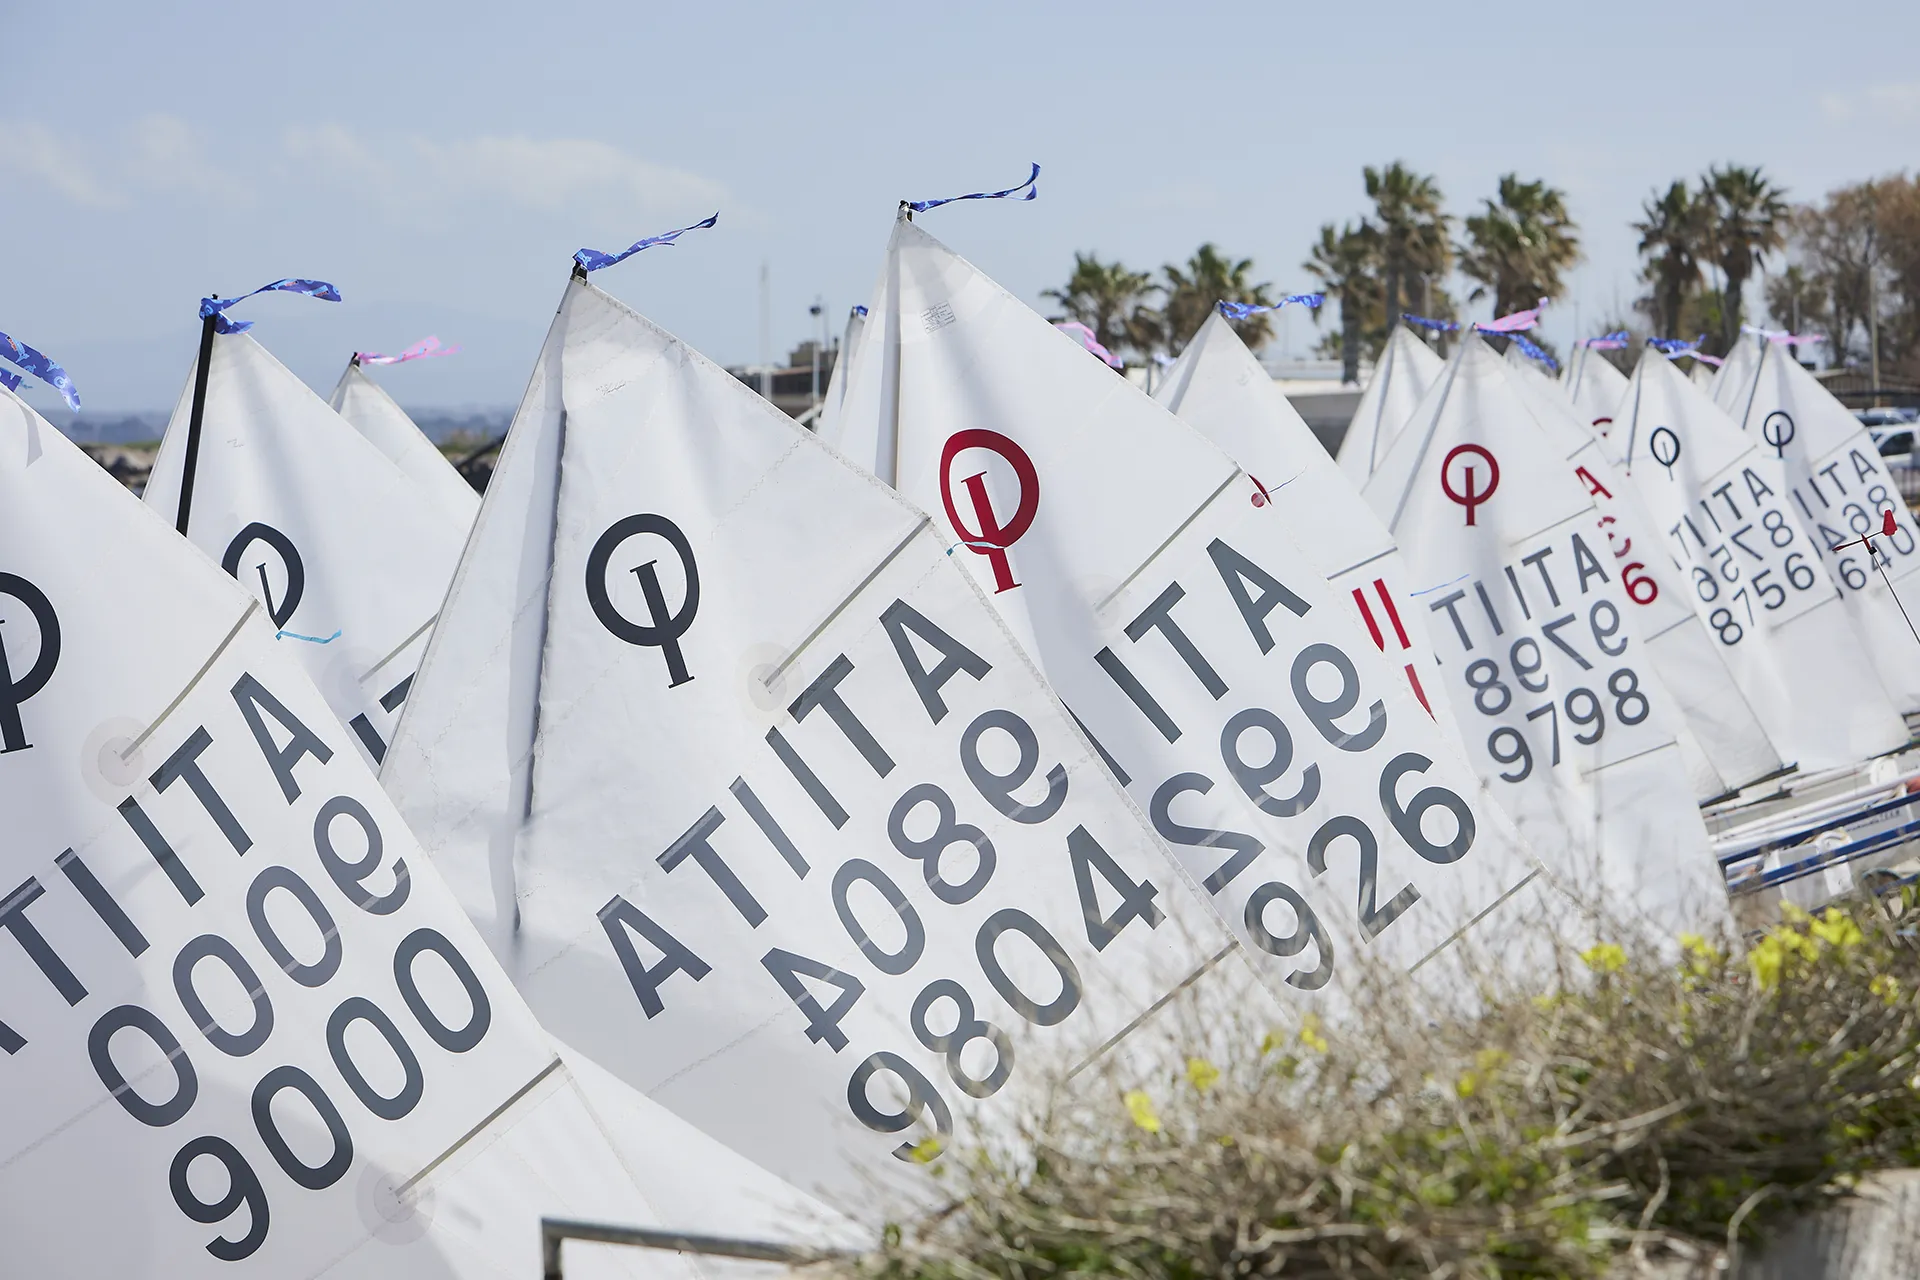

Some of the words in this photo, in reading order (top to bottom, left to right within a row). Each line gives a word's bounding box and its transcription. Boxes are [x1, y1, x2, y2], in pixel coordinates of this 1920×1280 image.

[1699, 468, 1774, 533] ITA
[1808, 448, 1878, 508] ITA
[1504, 533, 1611, 621] ITA
[1710, 553, 1815, 646] 8756
[1836, 524, 1915, 600] 640
[1094, 537, 1312, 745] ITA
[765, 598, 993, 831] ITA
[1487, 667, 1650, 784] 9798
[116, 672, 334, 907] ITA
[846, 824, 1167, 1164] 9804
[168, 928, 492, 1262] 9000
